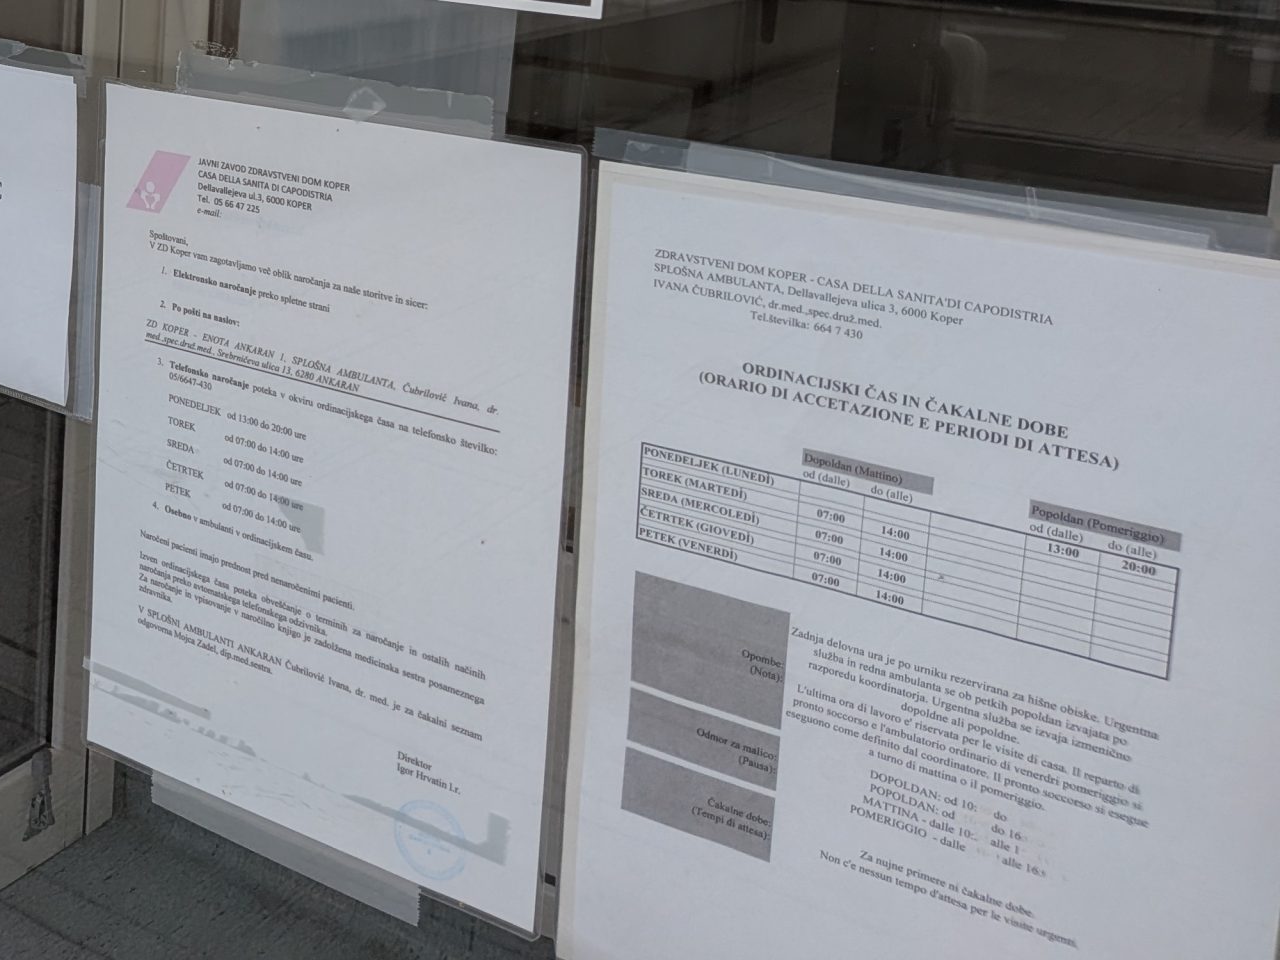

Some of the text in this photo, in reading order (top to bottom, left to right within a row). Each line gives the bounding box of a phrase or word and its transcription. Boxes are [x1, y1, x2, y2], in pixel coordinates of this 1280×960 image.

[198, 158, 350, 192] JAVNI ZAVOD ZDRAVSTVENI DOM KOPER
[197, 169, 333, 201] CASA DELLA SANITA DI CAPODISTRIA
[197, 194, 260, 214] Tel. 05 66 47 225
[265, 195, 285, 206] 6000
[286, 199, 312, 211] KOPER
[653, 278, 689, 293] IVANA
[691, 284, 766, 308] ČUBRILOVIĆ,
[653, 262, 704, 279] SPLOŠNA
[706, 273, 784, 295] AMBULANTA,
[860, 299, 885, 312] ulica
[888, 303, 898, 315] 3,
[900, 306, 927, 319] 6000
[930, 311, 964, 325] Koper
[654, 248, 734, 270] ZDRAVSTVENI
[737, 262, 765, 275] DOM
[767, 267, 807, 283] KOPER
[816, 276, 849, 290] CASA
[852, 282, 894, 298] DELLA
[963, 301, 1053, 325] CAPODISTRIA
[813, 322, 832, 333] 664
[834, 325, 841, 335] 7
[843, 328, 863, 339] 430
[168, 393, 221, 416] PONEDELJEK
[742, 362, 1068, 439] ORDINACIJSKI ČAS IN ČAKALNE DOBE
[167, 416, 196, 432] TOREK
[698, 372, 1119, 471] (ORARIO DI ACCETAZIONE E PERIODI DI ATTESA)
[166, 438, 195, 454] SREDA
[644, 446, 719, 472] PONEDELJEK
[166, 459, 204, 480] ČETRTEK
[642, 466, 682, 484] TOREK
[804, 452, 903, 485] Dopoldan (Mattino)
[165, 482, 191, 498] PETEK
[641, 487, 678, 504] SREDA
[640, 505, 694, 528] ČETRTEK
[816, 508, 846, 524] 07:00
[1031, 505, 1166, 545] Popoldan (Pomeriggio)
[639, 527, 676, 544] PETEK
[814, 529, 844, 545] 07:00
[880, 525, 910, 541] 14:00
[812, 551, 842, 567] 07:00
[878, 546, 909, 564] 14:00
[1047, 542, 1080, 560] 13:00
[876, 568, 907, 585] 14:00
[1121, 559, 1157, 577] 20:00
[810, 573, 840, 589] 07:00
[874, 590, 905, 607] 14:00
[397, 750, 432, 771] Direktor
[396, 762, 414, 776] Igor
[415, 769, 447, 789] Hrvatin
